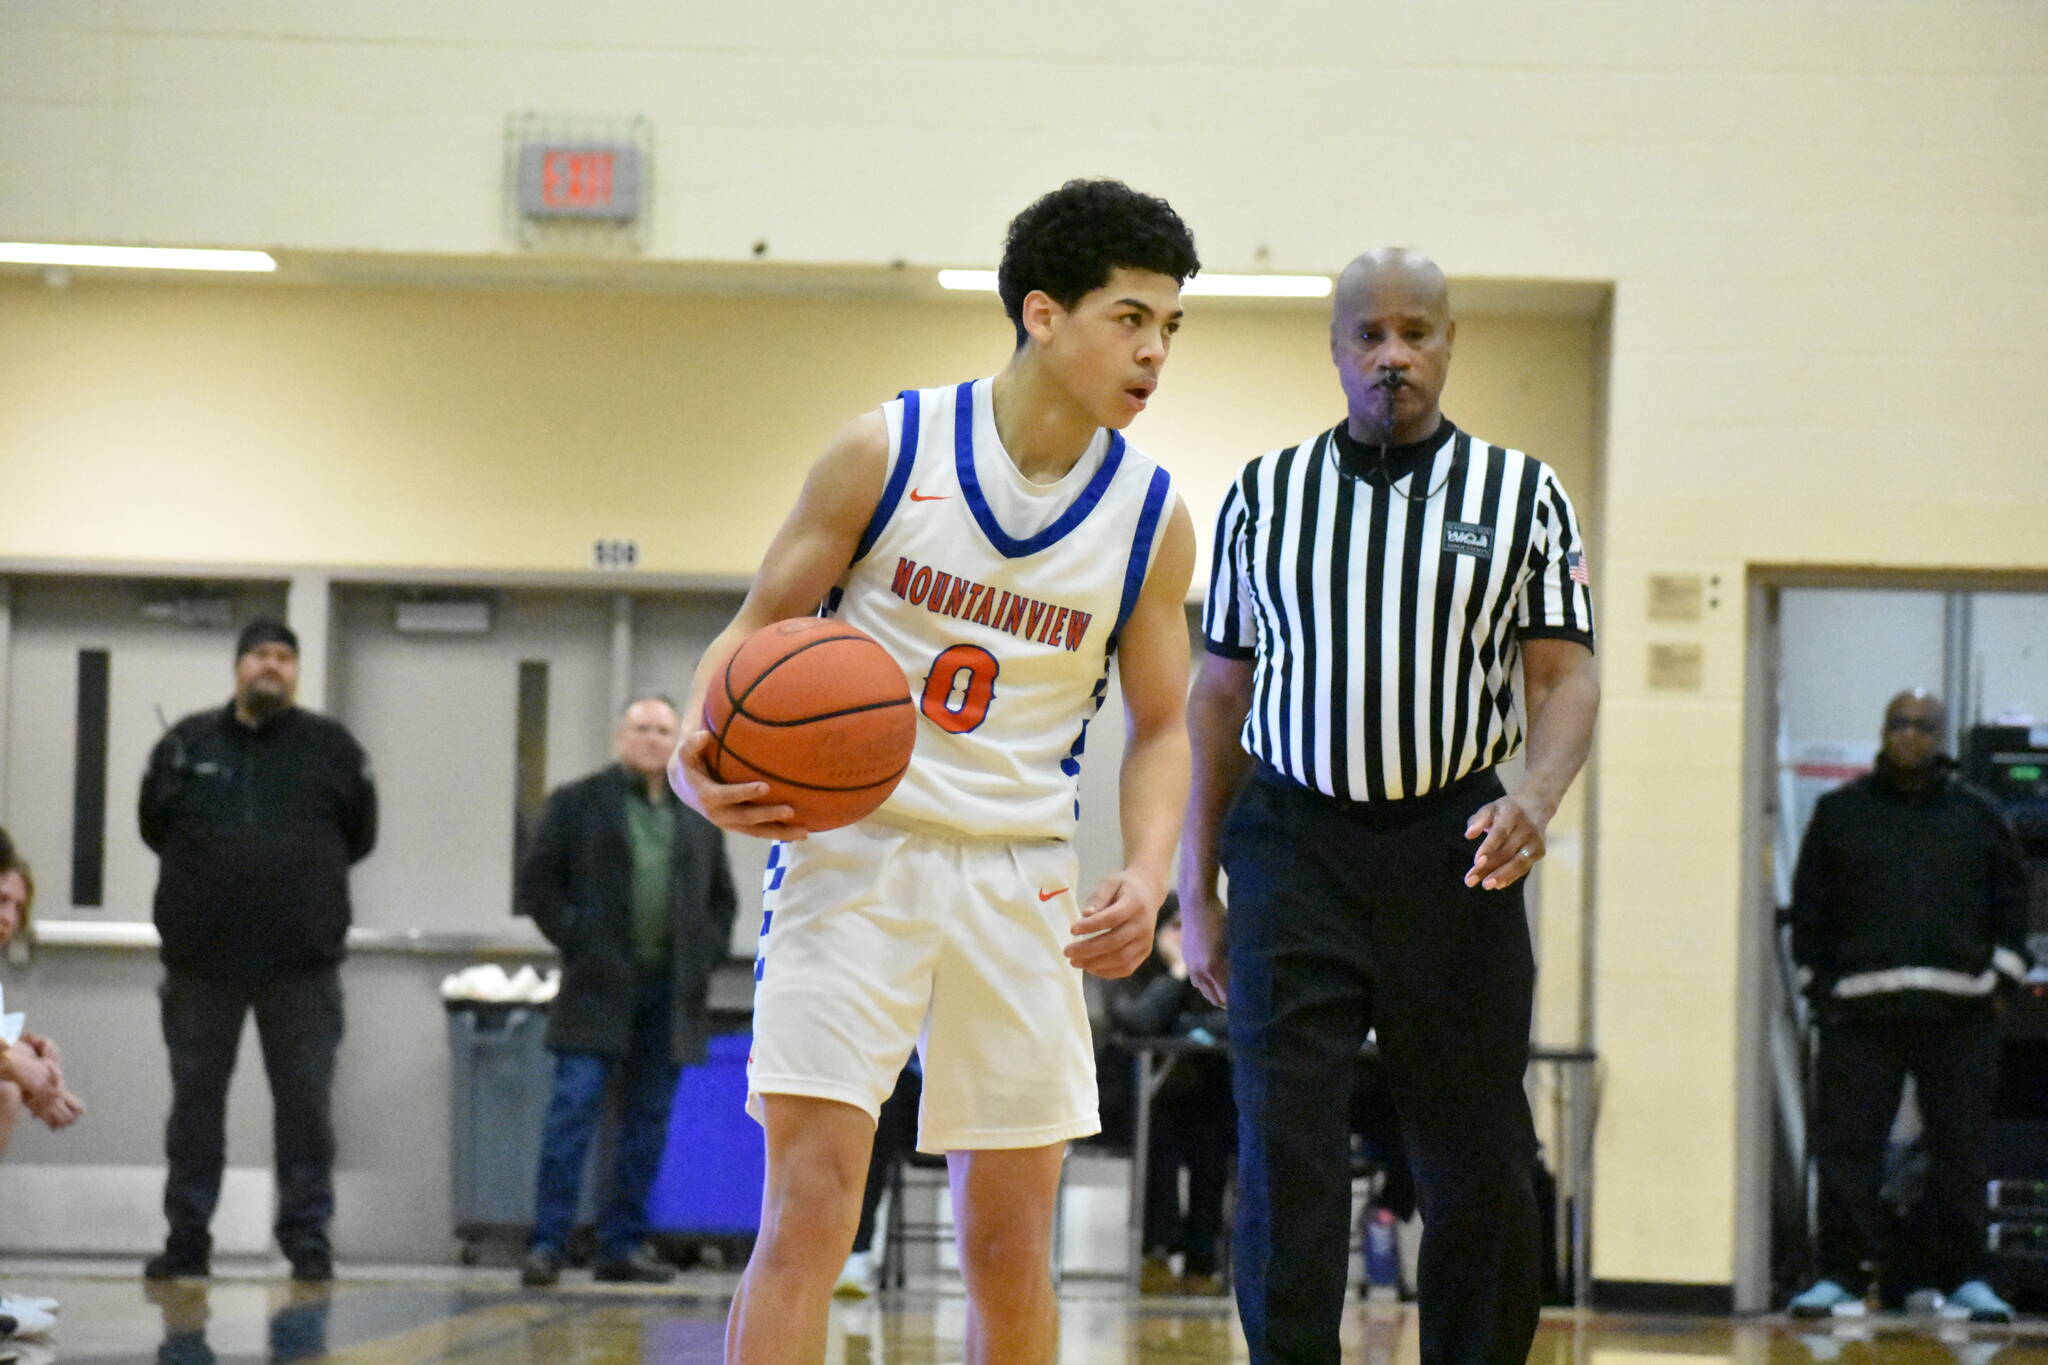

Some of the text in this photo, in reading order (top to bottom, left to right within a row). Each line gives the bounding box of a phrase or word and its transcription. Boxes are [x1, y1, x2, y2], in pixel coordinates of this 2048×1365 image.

[542, 150, 615, 207] EXIT
[891, 556, 1093, 653] MOUNTAINVIEW
[920, 643, 1000, 735] 0
